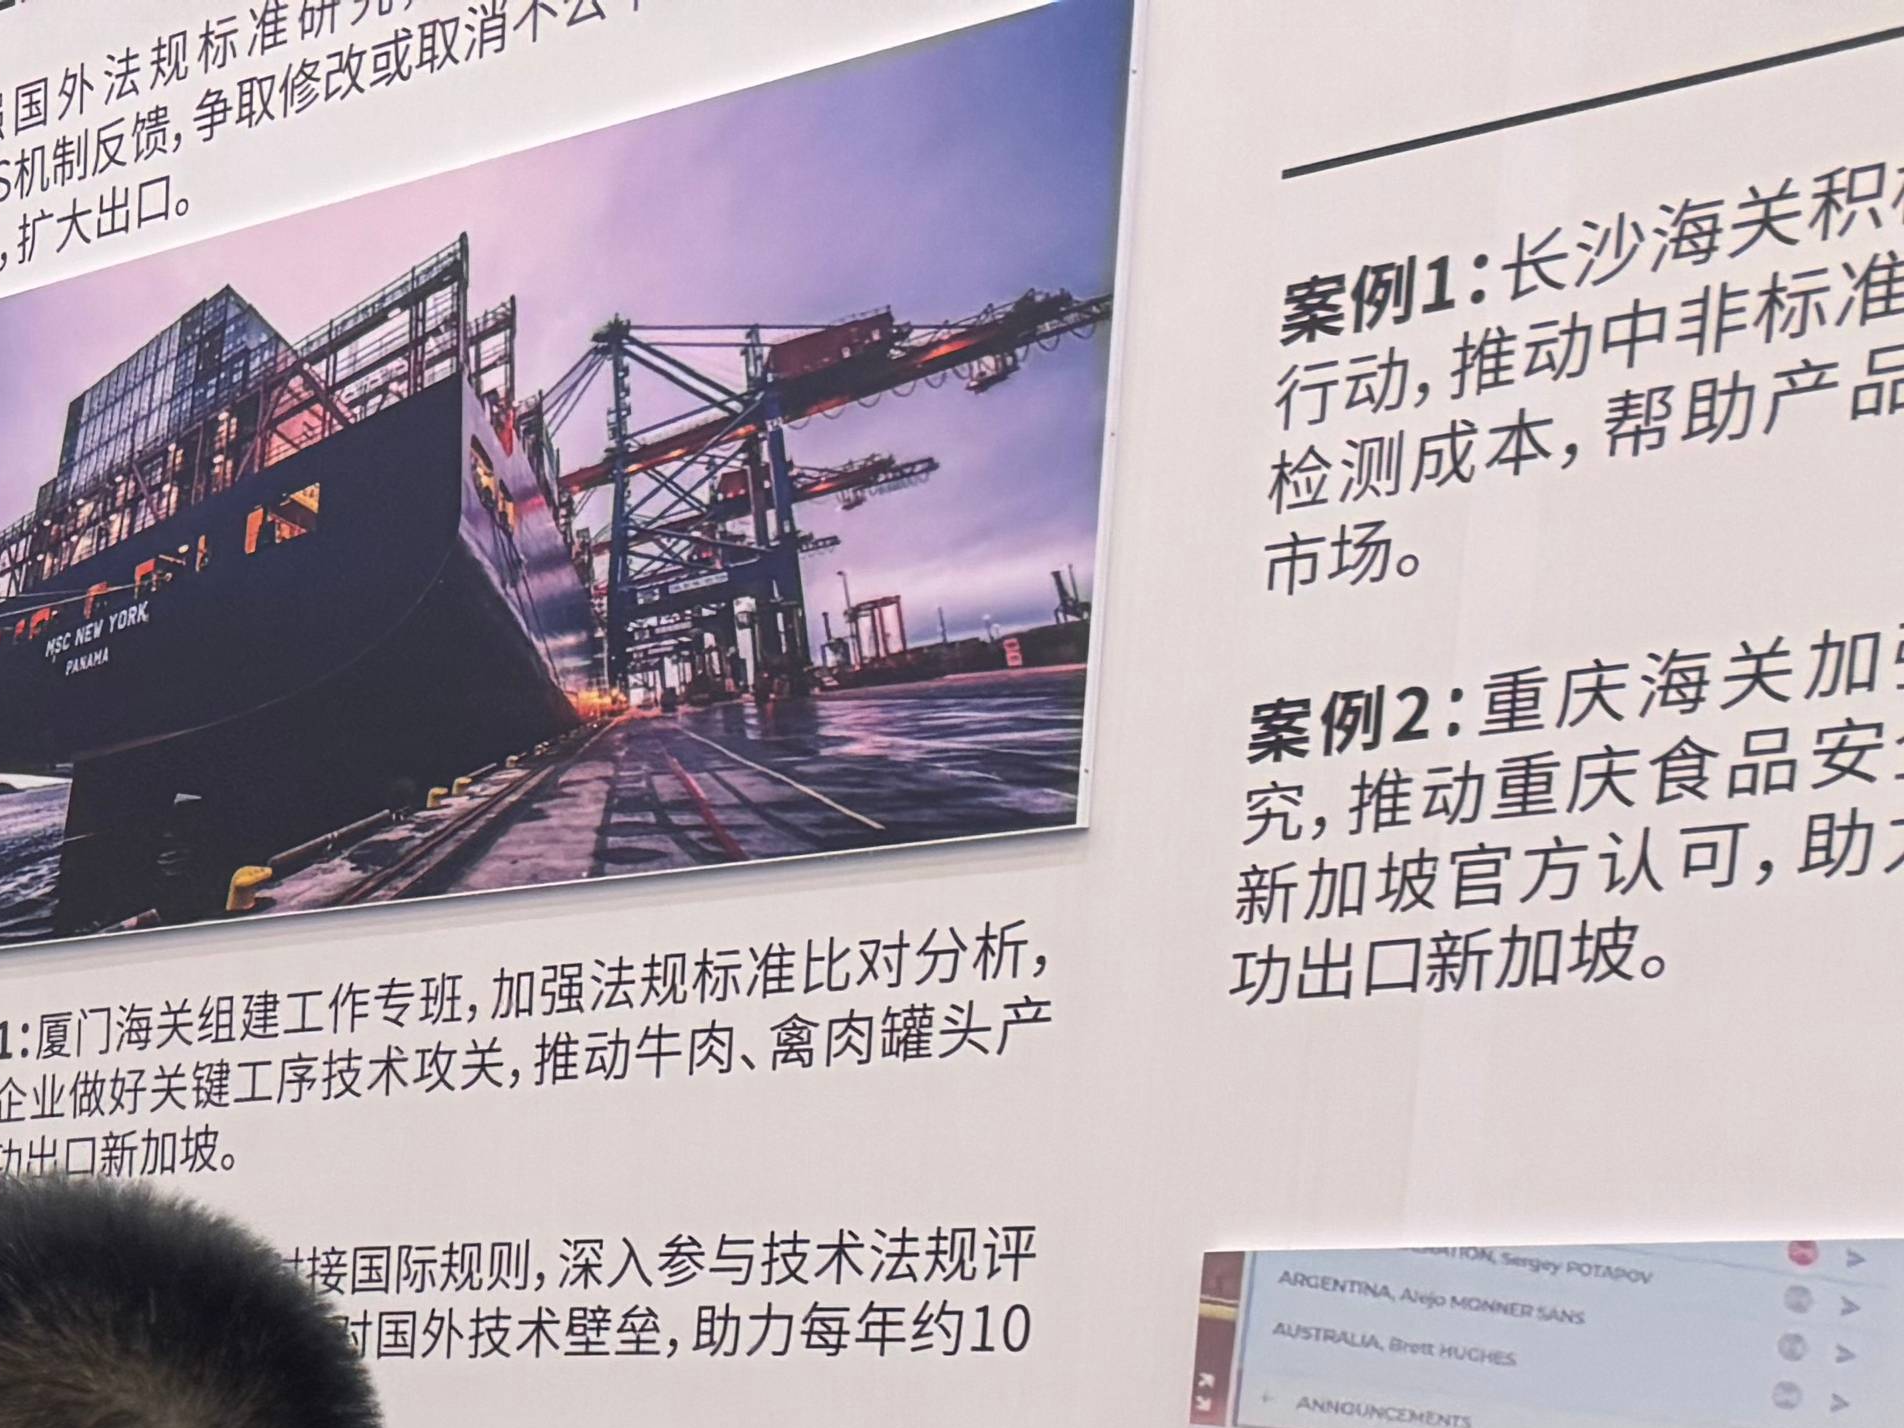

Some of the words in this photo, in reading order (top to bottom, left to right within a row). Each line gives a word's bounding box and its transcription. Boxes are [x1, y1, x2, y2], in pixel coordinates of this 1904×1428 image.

[1281, 161, 1904, 347] 案例1：长沙海关积
[1264, 519, 1420, 596] 市场。
[45, 632, 71, 658] MSC
[74, 618, 104, 646] NEW
[109, 600, 150, 633] YORK
[65, 646, 110, 676] PANAMA
[1246, 622, 1904, 765] 案例2：重庆海关加
[1242, 716, 1904, 846] 究，推动重庆食品安
[1228, 915, 1667, 1007] 功出口新加坡。
